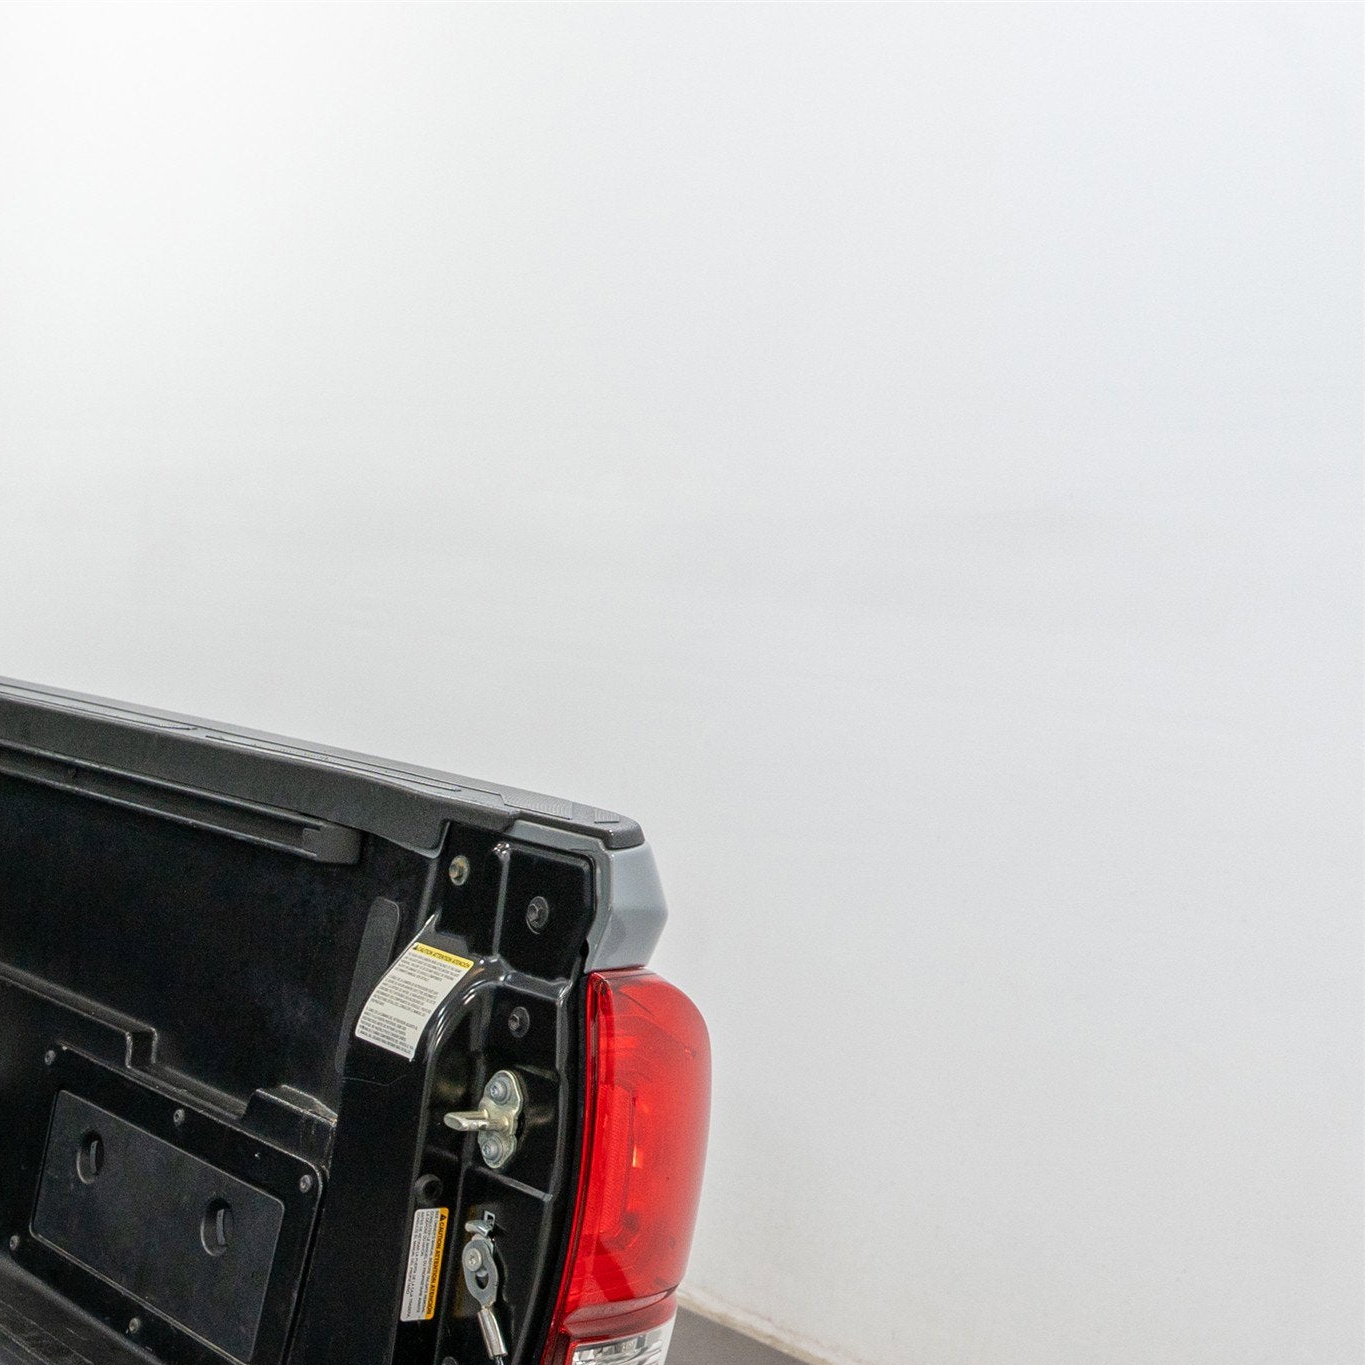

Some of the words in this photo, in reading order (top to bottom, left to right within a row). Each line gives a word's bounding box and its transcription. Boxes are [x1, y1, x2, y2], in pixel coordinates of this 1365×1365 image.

[435, 1221, 444, 1248] CAUTION
[430, 1249, 440, 1283] ATTENTION
[426, 1284, 436, 1314] ATENCIÓN
